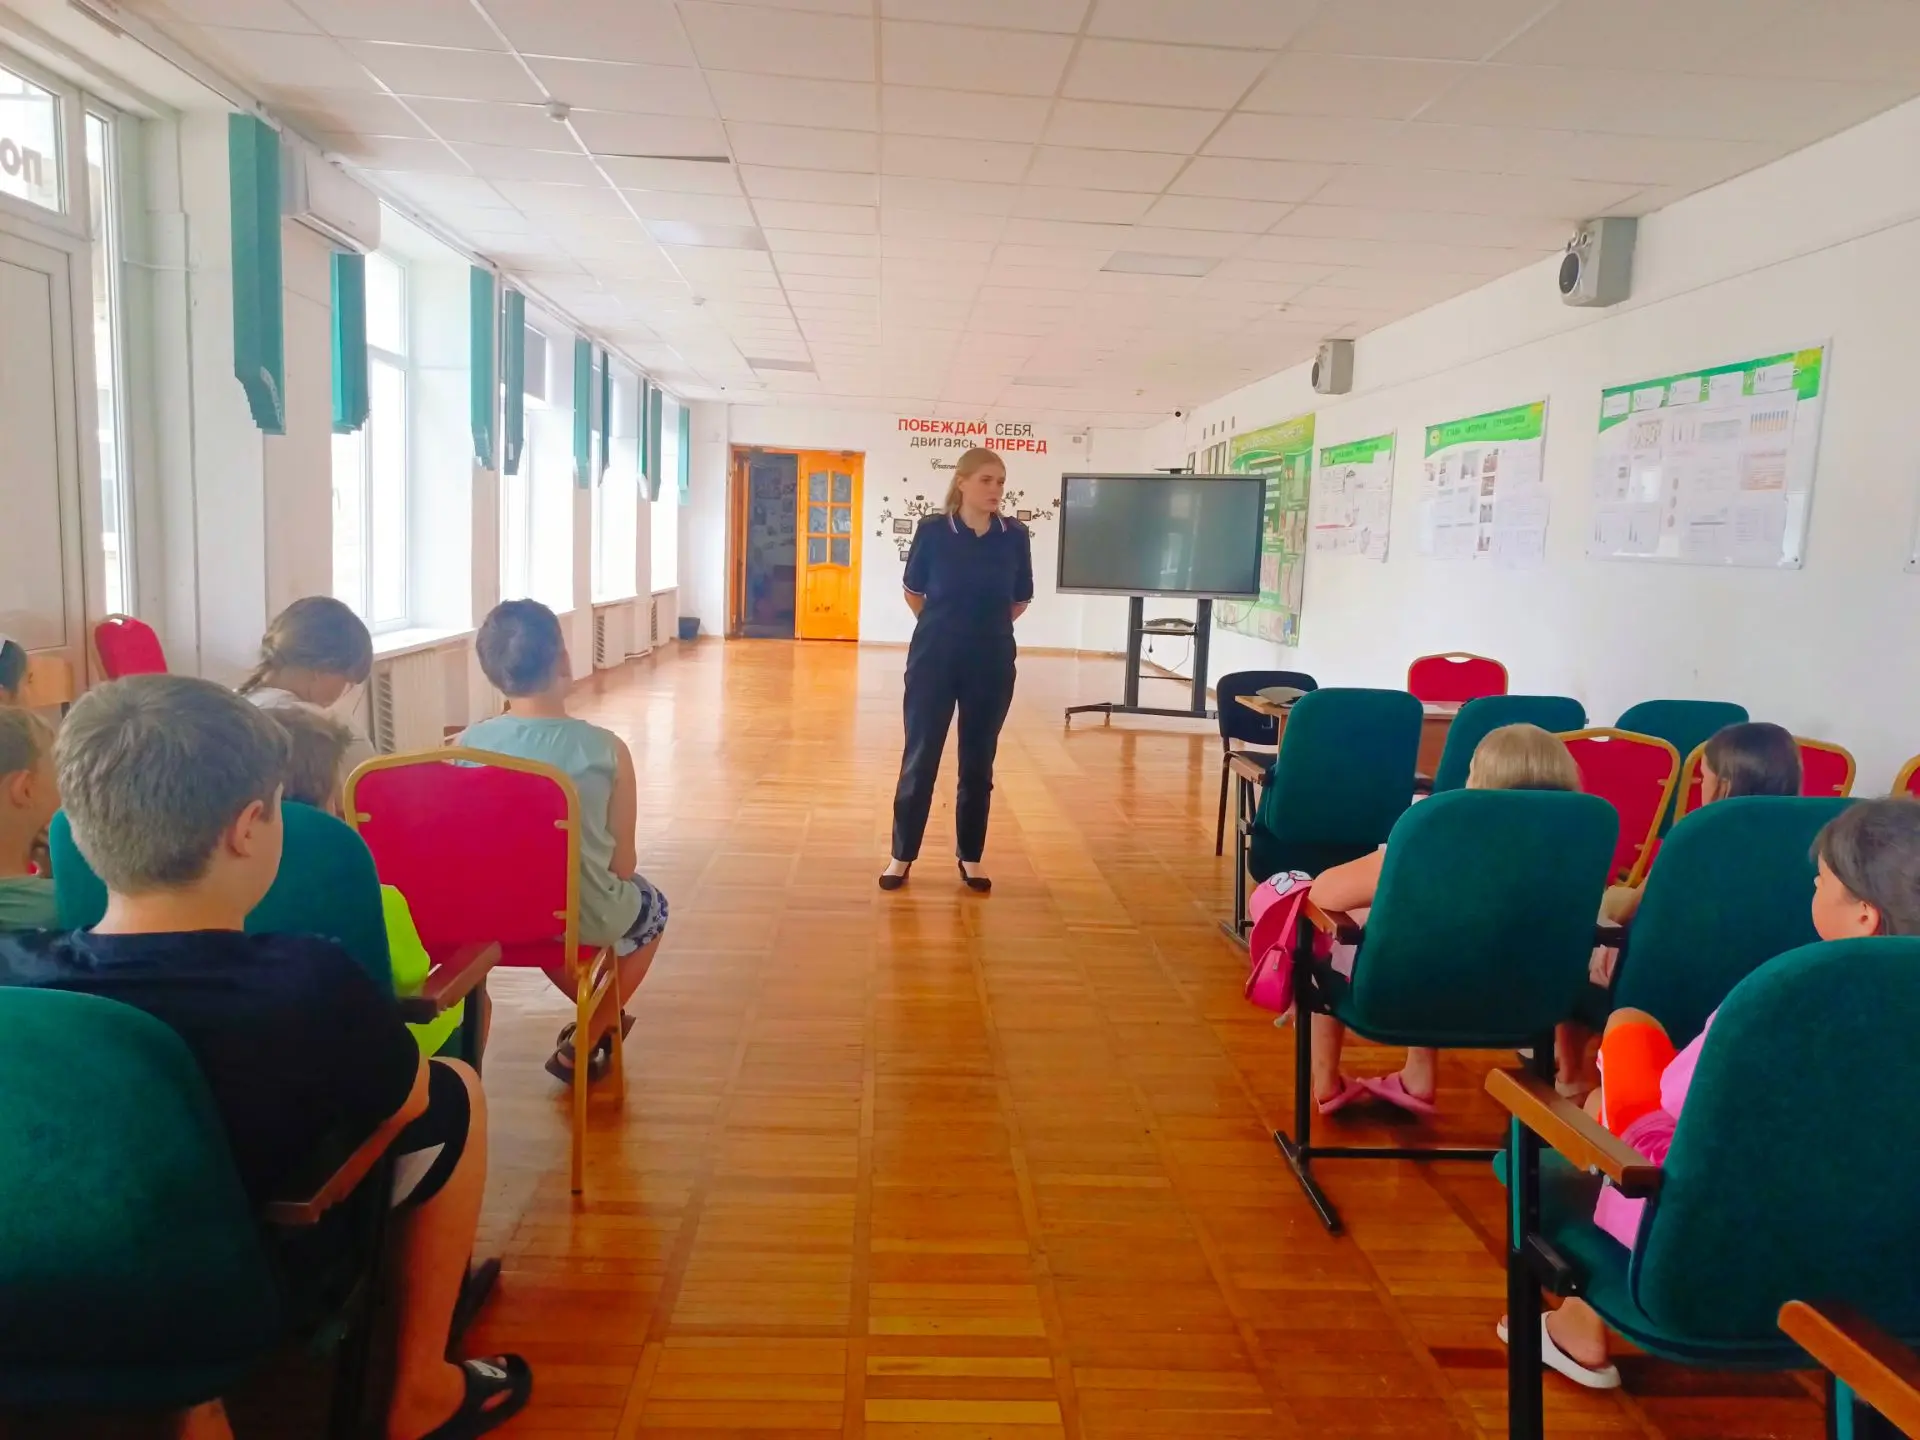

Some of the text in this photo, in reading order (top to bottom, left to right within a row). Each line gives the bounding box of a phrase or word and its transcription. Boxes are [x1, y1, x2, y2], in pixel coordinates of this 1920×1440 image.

[898, 418, 1034, 438] ПОБЕЖДАЙ СЕБЯ,
[910, 436, 1047, 454] двигаясь ВПЕРЕД
